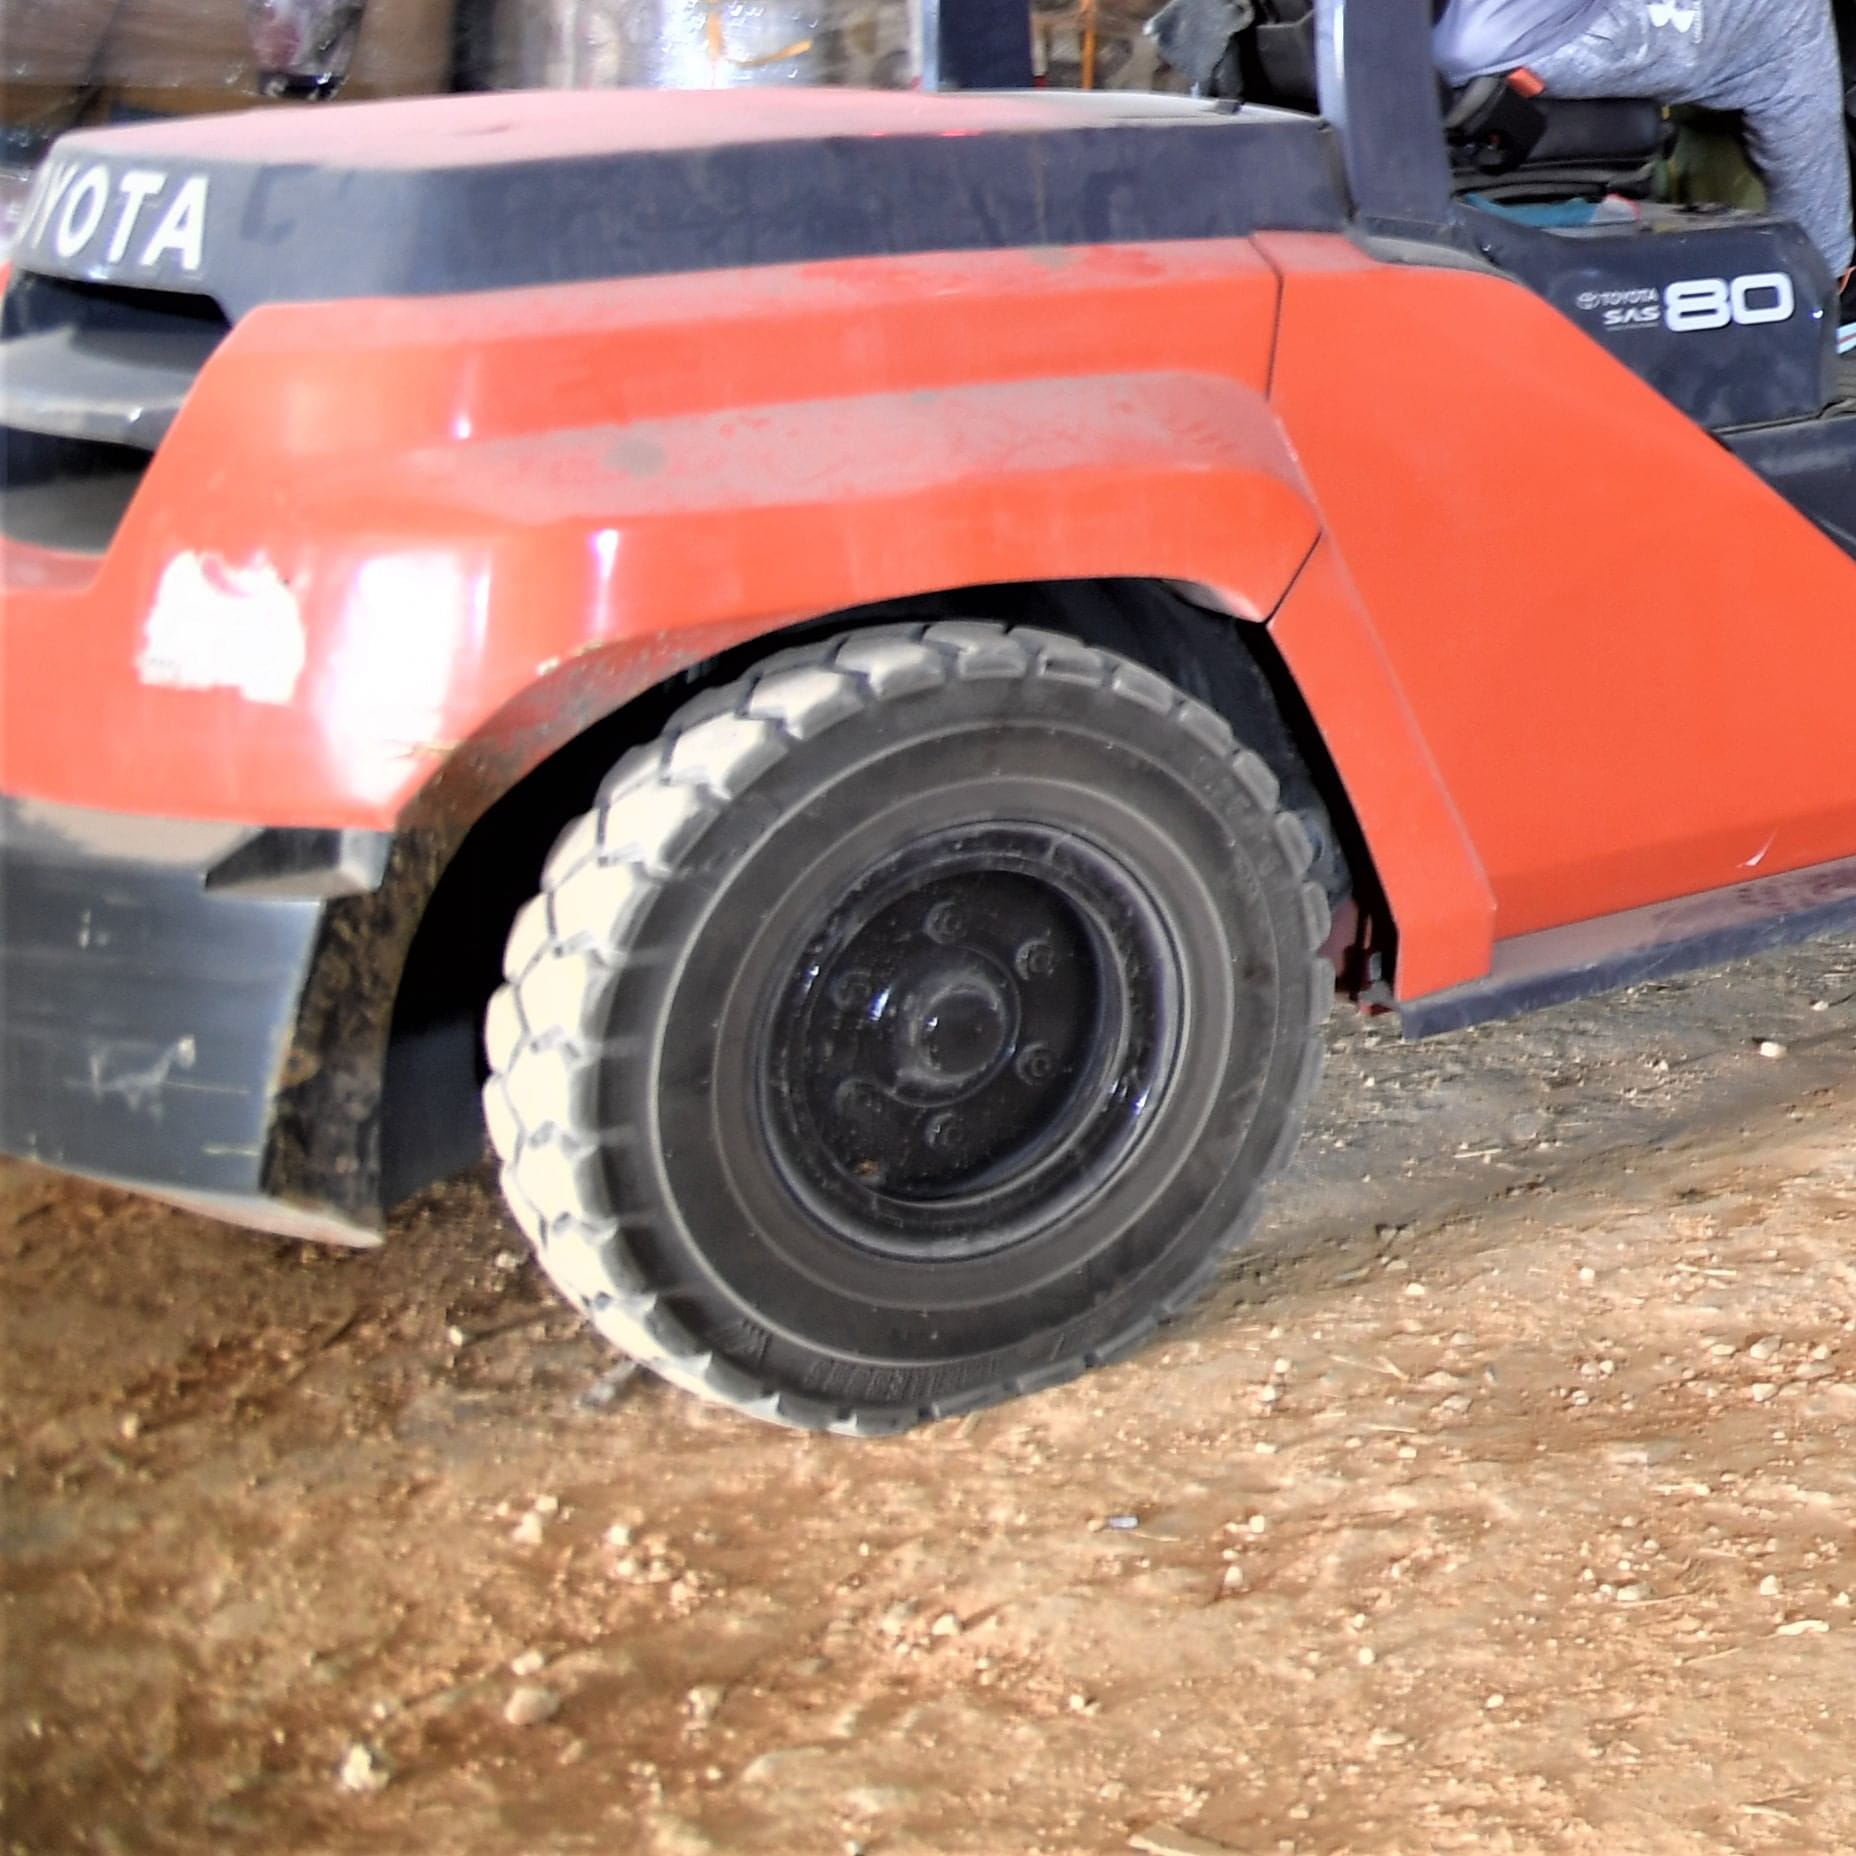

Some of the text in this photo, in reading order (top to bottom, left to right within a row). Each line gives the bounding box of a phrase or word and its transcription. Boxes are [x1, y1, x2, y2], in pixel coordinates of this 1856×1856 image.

[30, 162, 209, 271] YOTA
[1601, 287, 1660, 306] TOYOTA
[1603, 271, 1796, 332] SAS 80
